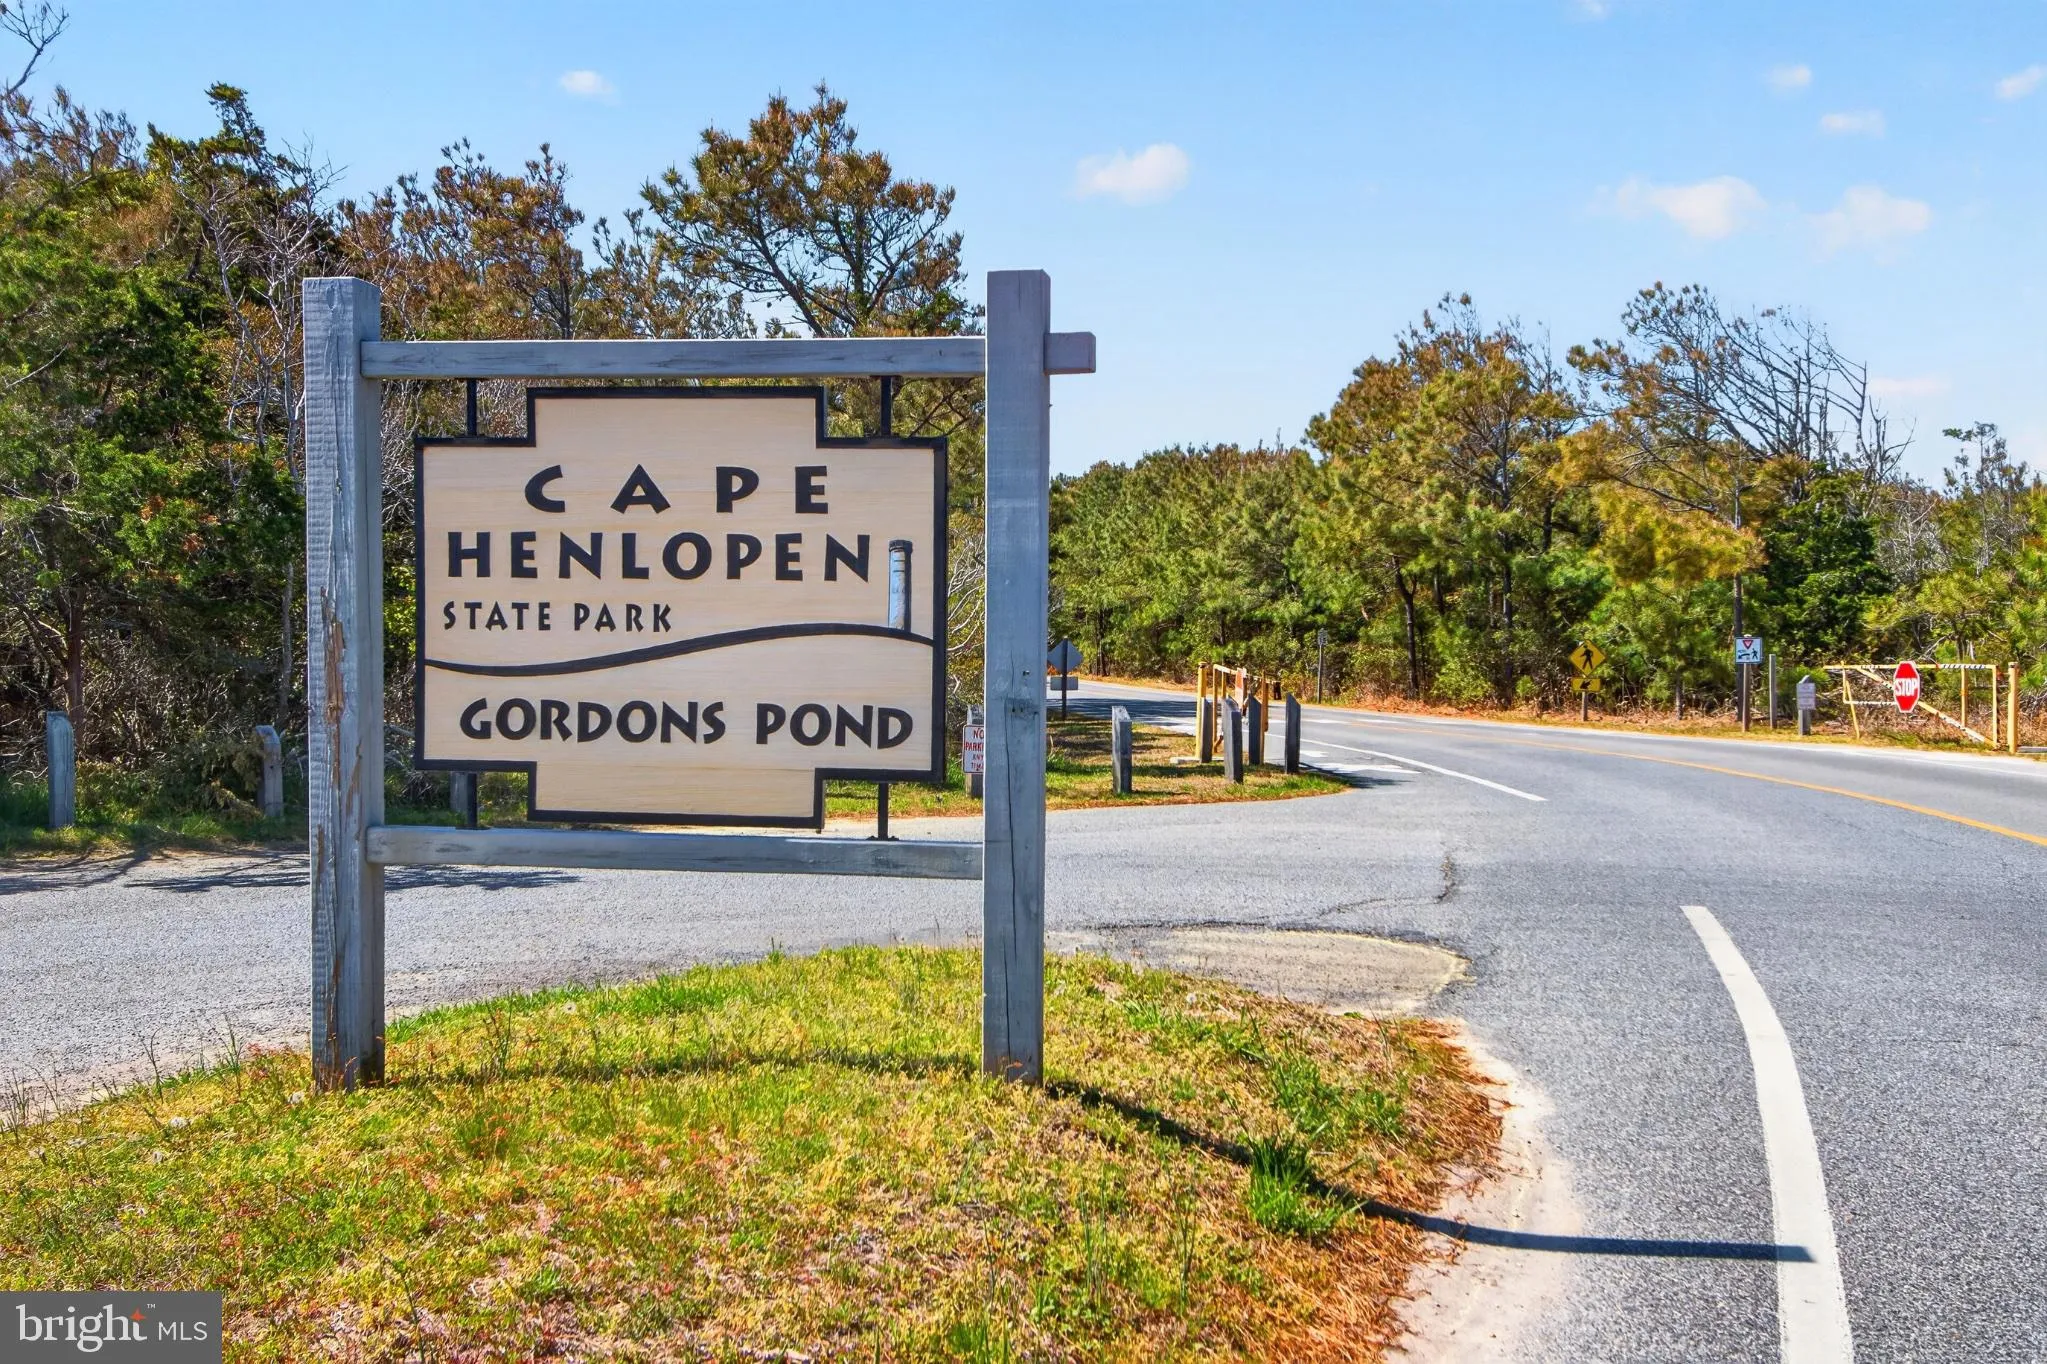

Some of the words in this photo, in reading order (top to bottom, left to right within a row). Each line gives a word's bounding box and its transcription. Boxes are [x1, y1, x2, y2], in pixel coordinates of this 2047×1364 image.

[524, 463, 829, 515] CAPE
[447, 530, 871, 583] HENLOPEN
[443, 600, 551, 631] STATE
[573, 602, 672, 633] PARK
[1895, 678, 1918, 696] STOP
[459, 697, 726, 745] GORDONS
[755, 703, 914, 750] POND
[973, 729, 985, 739] NO
[965, 742, 984, 751] PARKI
